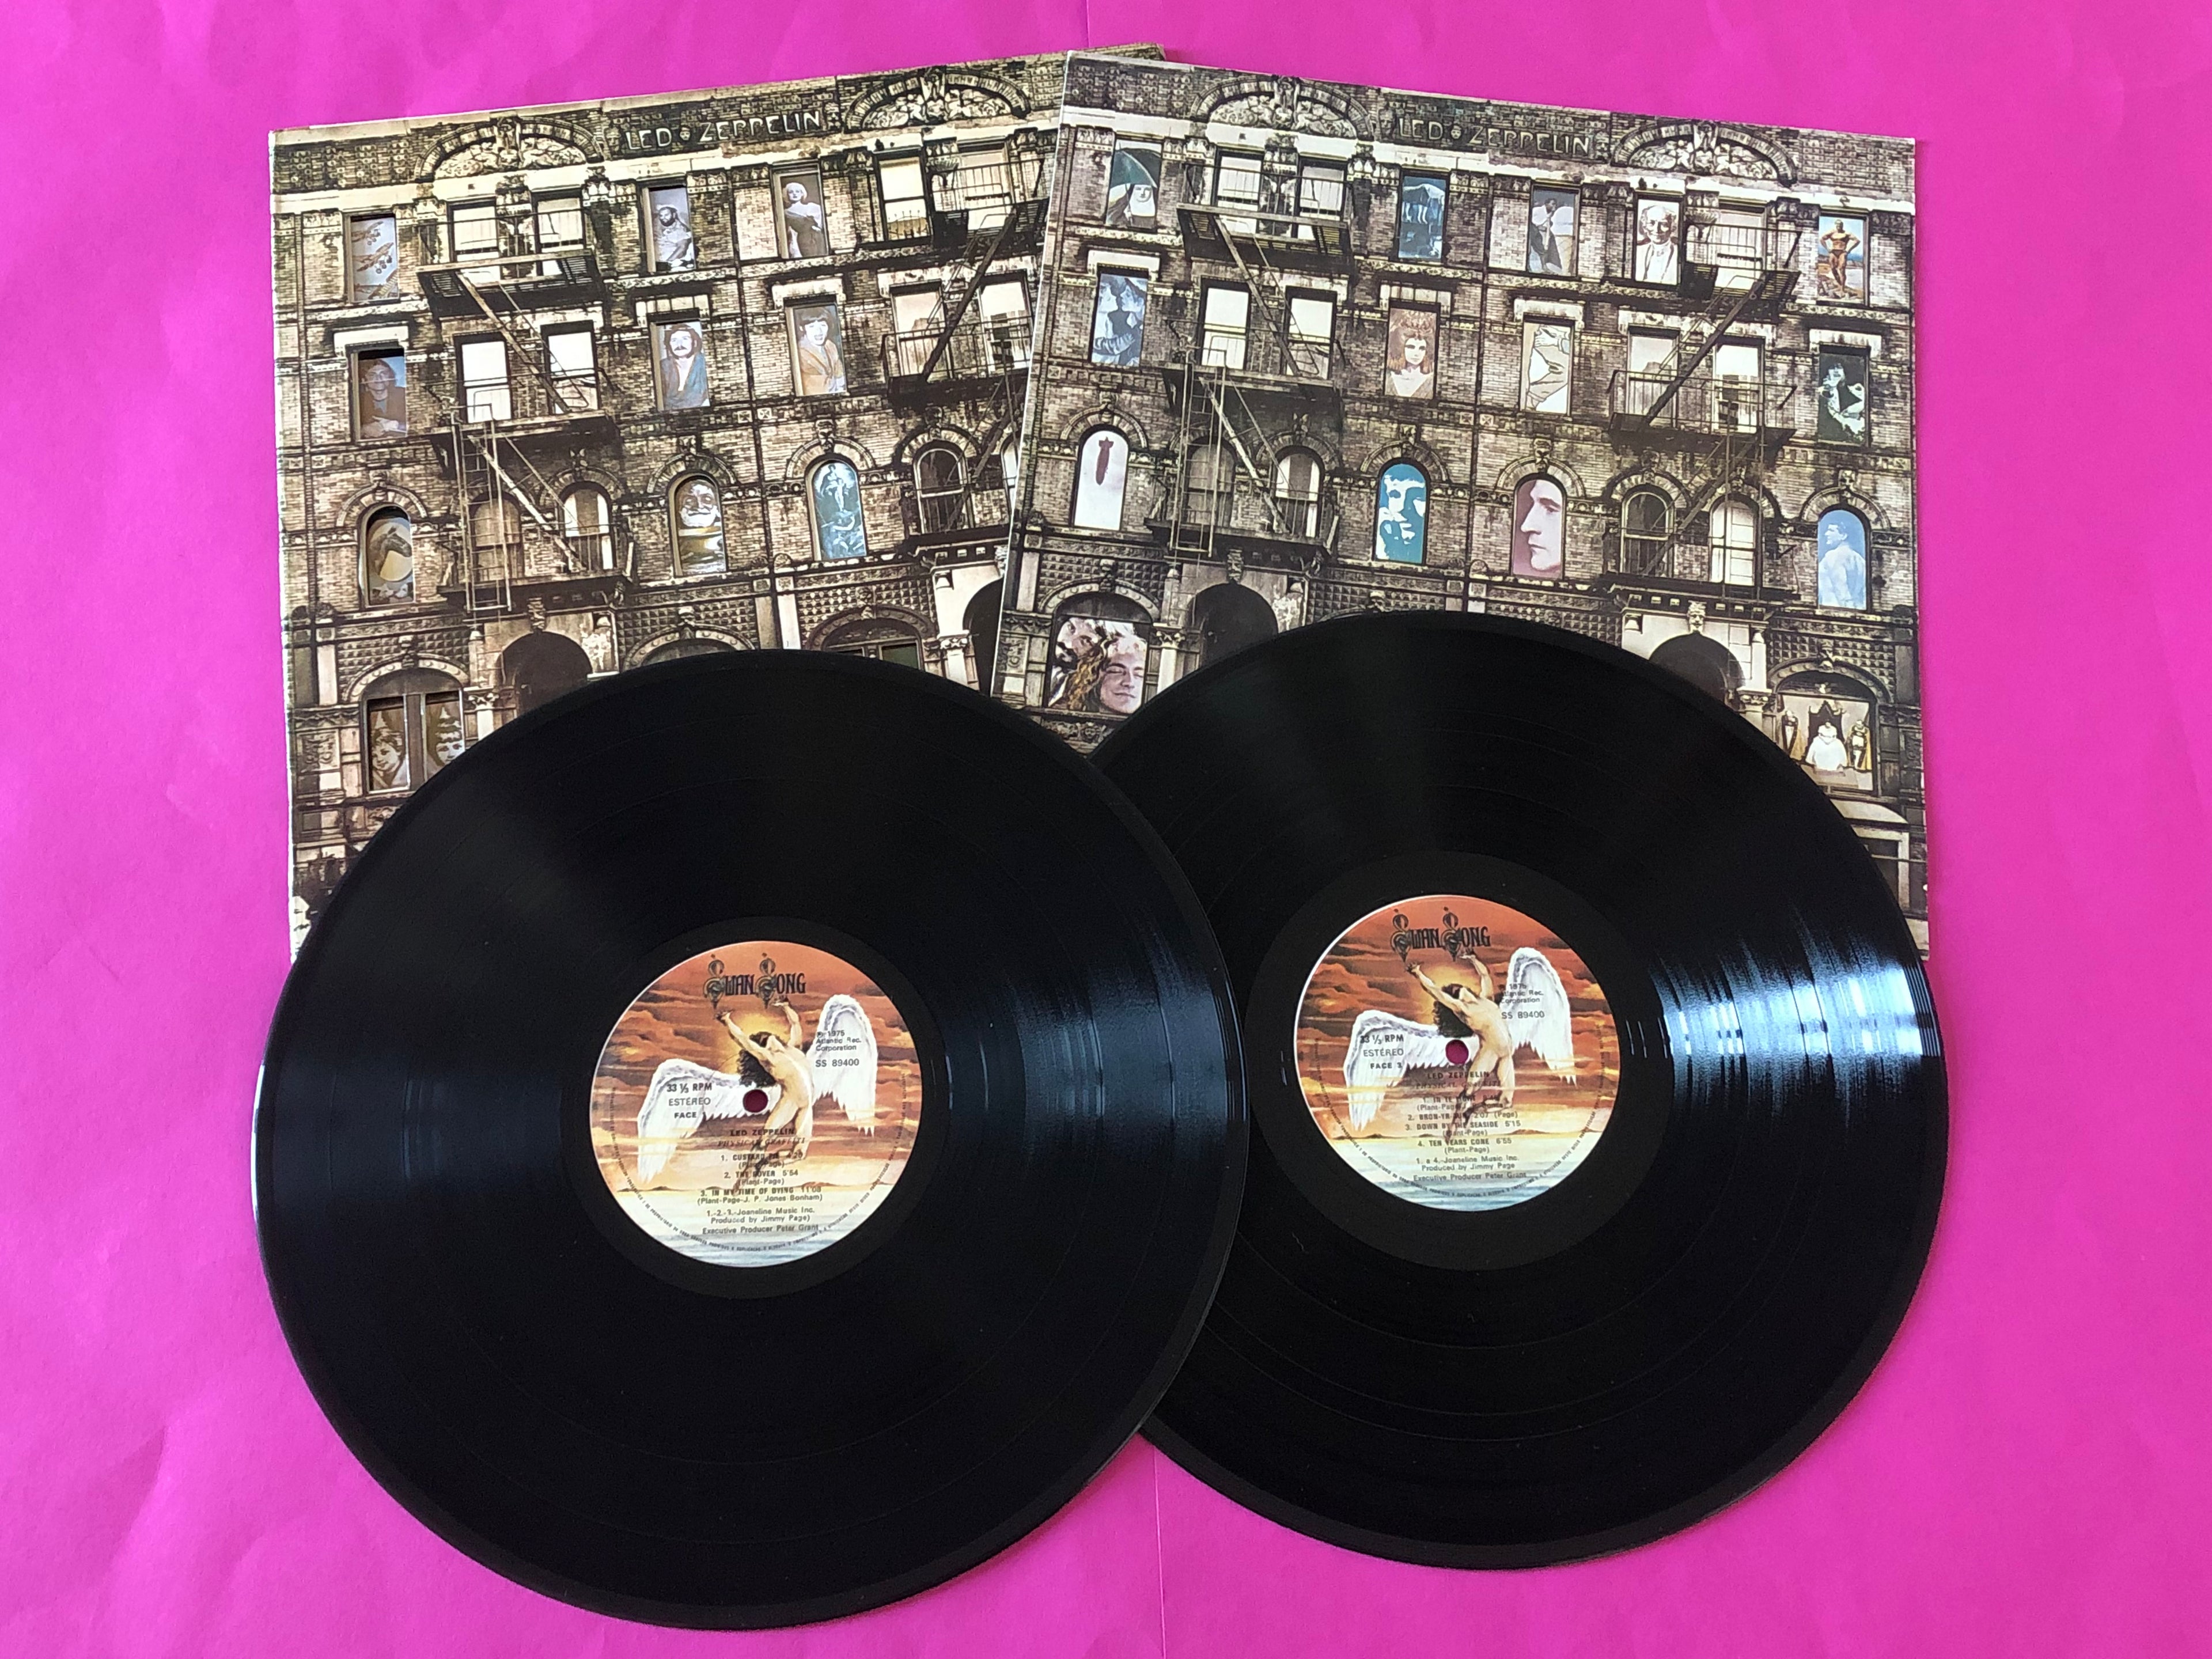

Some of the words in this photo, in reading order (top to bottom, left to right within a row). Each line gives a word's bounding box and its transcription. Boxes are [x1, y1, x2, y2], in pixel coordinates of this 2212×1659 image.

[626, 128, 672, 150] LED
[698, 111, 820, 142] ZEPPELIN
[1399, 118, 1443, 141] LED
[1467, 125, 1589, 154] ZEPPELIN
[1501, 1012, 1513, 1020] SS
[1517, 1010, 1545, 1019] 89400
[1384, 1033, 1404, 1043] RPM
[816, 1044, 857, 1052] Corporation
[815, 1059, 827, 1067] SS
[832, 1058, 859, 1067] 89400
[666, 1084, 677, 1092] 33
[692, 1082, 712, 1091] RPM
[1494, 1111, 1518, 1119] (Page)
[752, 1128, 794, 1136] ZEPPELIN
[1444, 1146, 1490, 1154] (Plant-Page)
[789, 1214, 810, 1222] Page)
[702, 1227, 737, 1235] Executive
